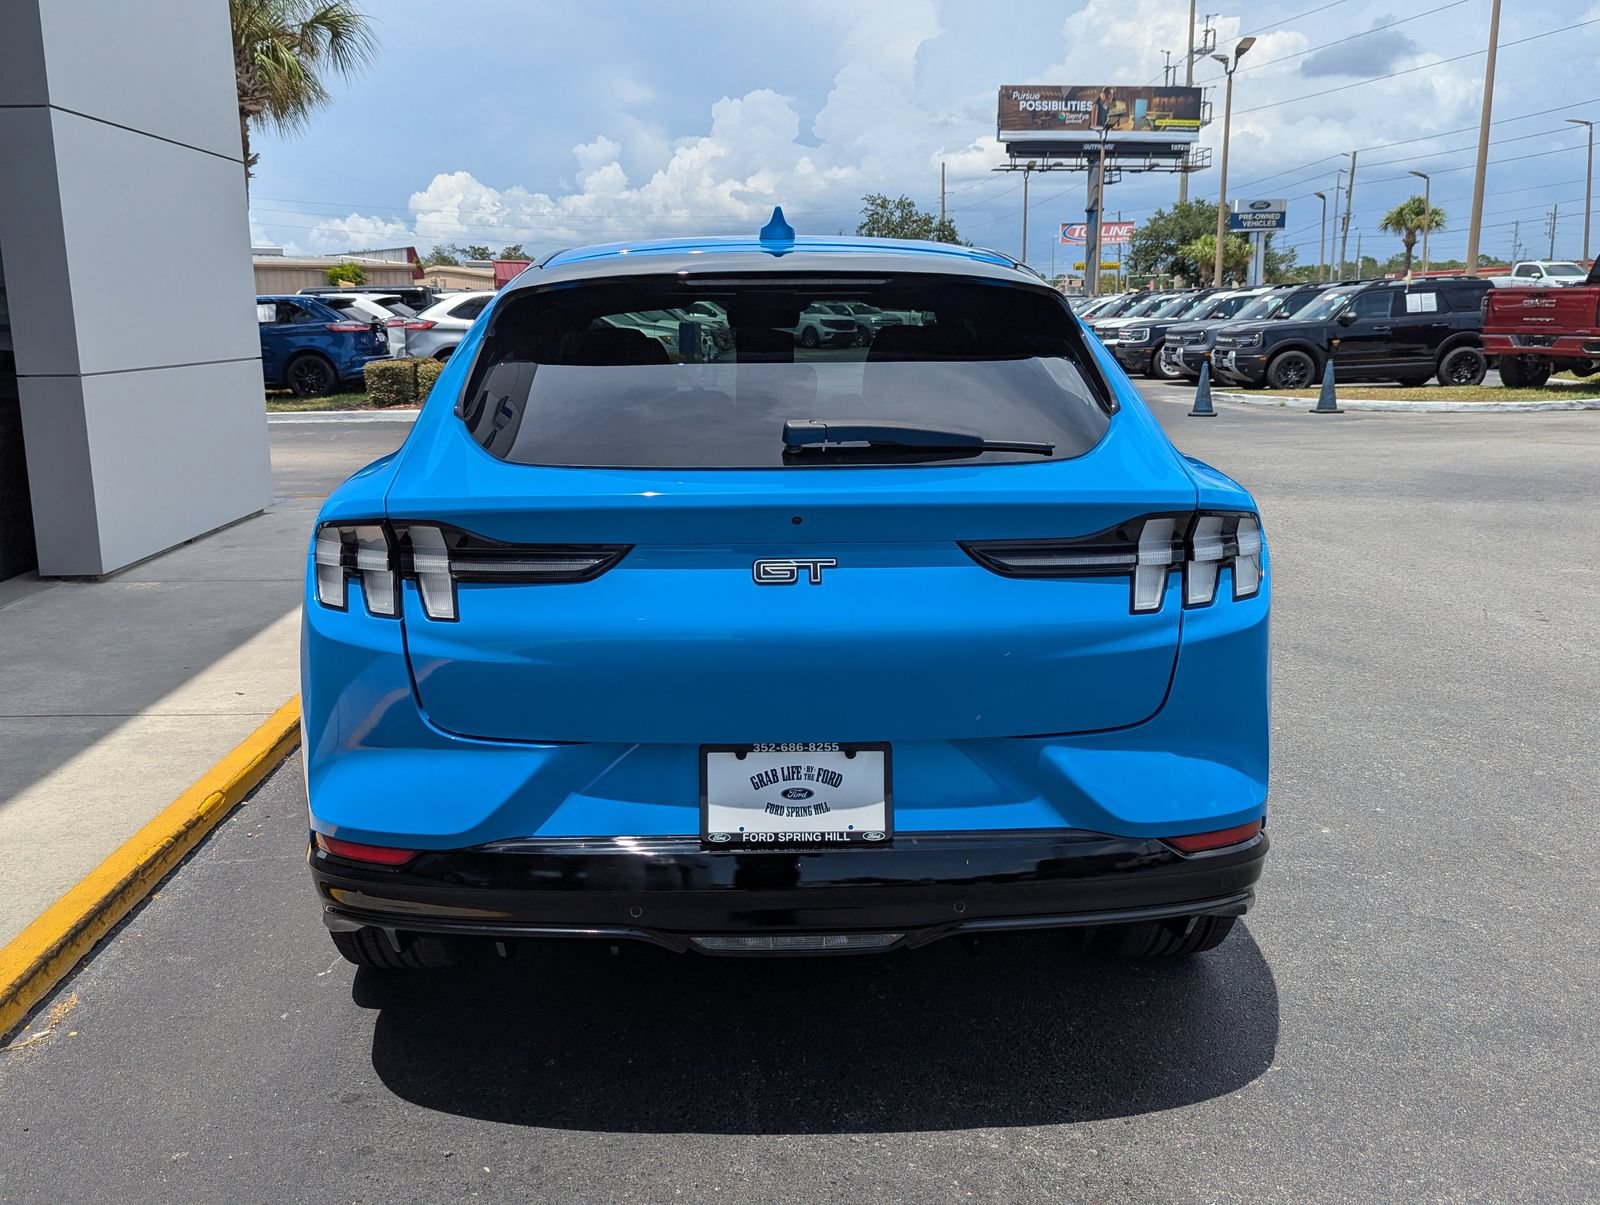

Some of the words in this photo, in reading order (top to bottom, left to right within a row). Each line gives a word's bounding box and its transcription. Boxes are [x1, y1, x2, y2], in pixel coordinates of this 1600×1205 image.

[1012, 91, 1040, 100] Pursue
[1019, 100, 1093, 112] POSSIBILITIES
[1238, 213, 1280, 221] PRE-OWNED
[753, 558, 837, 585] GT
[753, 742, 839, 752] 352-686-8255
[750, 768, 779, 791] GRAB
[780, 765, 802, 782] LIFE
[816, 767, 843, 789] FORD
[786, 788, 809, 799] Ford
[764, 802, 785, 817] FORD
[785, 805, 813, 818] SPRING
[812, 801, 831, 815] HILL
[742, 833, 775, 842] FORD
[778, 832, 822, 842] SPRING
[825, 832, 850, 841] HILL
